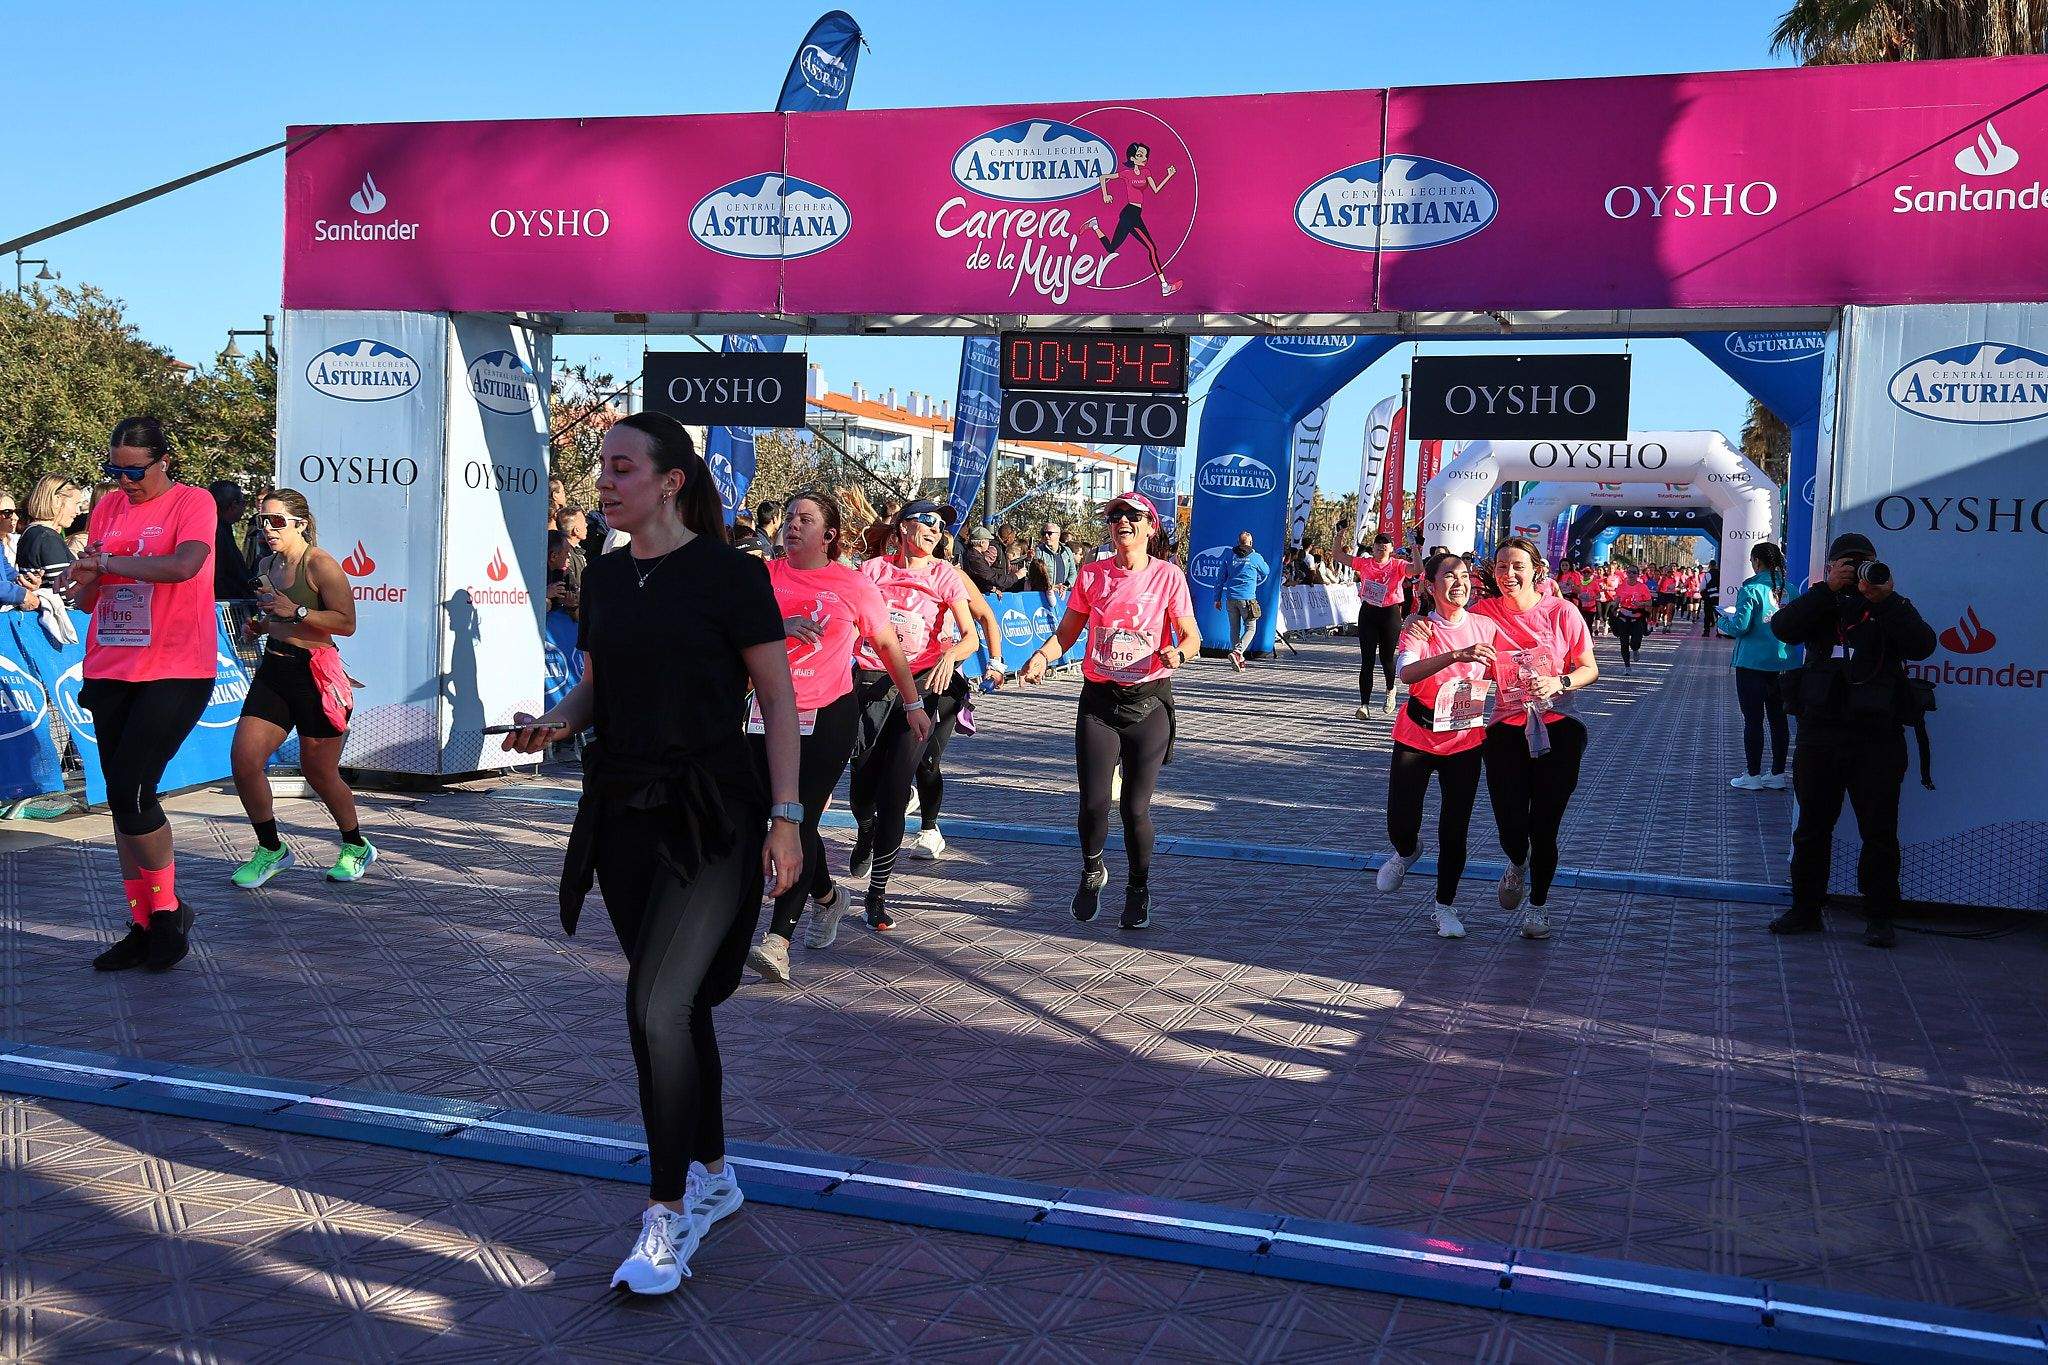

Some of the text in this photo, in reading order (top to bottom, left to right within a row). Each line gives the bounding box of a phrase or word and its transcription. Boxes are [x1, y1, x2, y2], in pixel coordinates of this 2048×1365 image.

[990, 146, 1100, 157] CENTRAL LECHERA
[964, 151, 1102, 181] ASTURIANA
[1341, 186, 1476, 199] CENTRAL LECHERA
[1604, 181, 1778, 219] OYSHO
[1892, 182, 2048, 214] Santande
[700, 205, 838, 237] ASTURIANA
[726, 203, 775, 212] CENTRAL
[935, 197, 1071, 239] Carrera
[1309, 192, 1482, 227] ASTURIANA
[315, 219, 420, 242] Santander
[490, 208, 610, 239] OYSHO
[966, 232, 1120, 305] de la Mujer
[1733, 336, 1825, 353] ASTURIANA
[315, 363, 413, 387] ASTURIANA
[473, 368, 536, 403] ASTURIANA
[1901, 372, 2048, 404] ASTURIAN
[1932, 371, 2048, 379] CENTRAL LECHE
[668, 377, 782, 404] OYSHO
[1445, 384, 1596, 415] OYSHO
[1009, 399, 1178, 439] OYSHO
[1386, 430, 1399, 501] Santander
[1529, 441, 1668, 471] OYSHO
[299, 455, 418, 486] OYSHO
[464, 461, 538, 494] OYSHO
[1201, 468, 1271, 490] ASTURIANA
[1448, 470, 1488, 480] OYSHO
[1707, 473, 1751, 482] OYSHO
[1427, 523, 1465, 532] OYSHO
[1614, 510, 1697, 519] VOLVO
[467, 586, 530, 605] Santander
[113, 611, 132, 621] 016
[1111, 651, 1133, 661] 016
[1904, 660, 2048, 688] antander
[1452, 701, 1471, 710] 016
